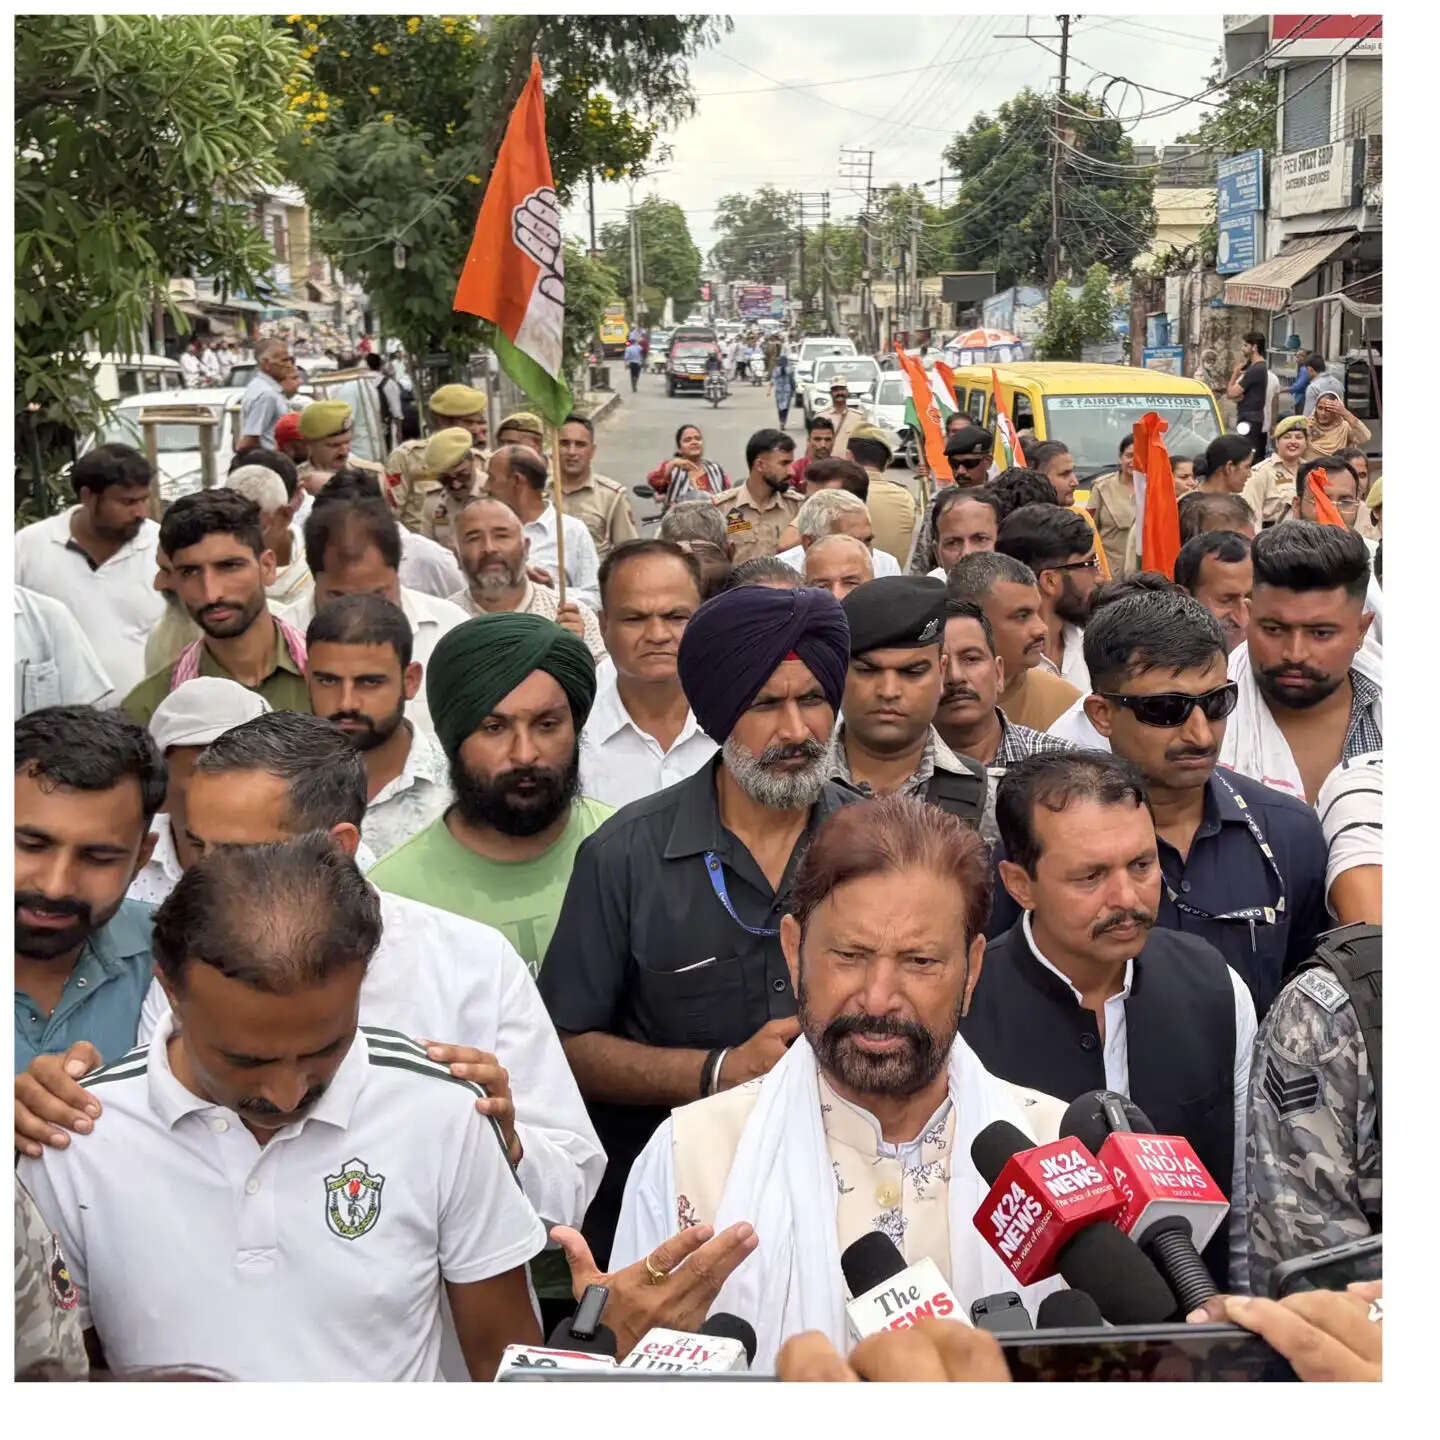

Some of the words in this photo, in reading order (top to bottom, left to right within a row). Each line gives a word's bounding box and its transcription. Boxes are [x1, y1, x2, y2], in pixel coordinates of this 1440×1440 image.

[1077, 397, 1142, 406] FAIRDEAL
[1146, 397, 1200, 406] MOTORS
[1137, 1139, 1176, 1157] RTI
[1040, 1149, 1088, 1179] JK24
[1136, 1154, 1202, 1174] INDIA
[1044, 1165, 1103, 1198] NEWS
[1150, 1172, 1208, 1189] NEWS
[990, 1181, 1027, 1238] JK24
[998, 1195, 1043, 1260] NEWS
[873, 1285, 921, 1318] The
[881, 1292, 954, 1334] EWS
[643, 1342, 718, 1366] early
